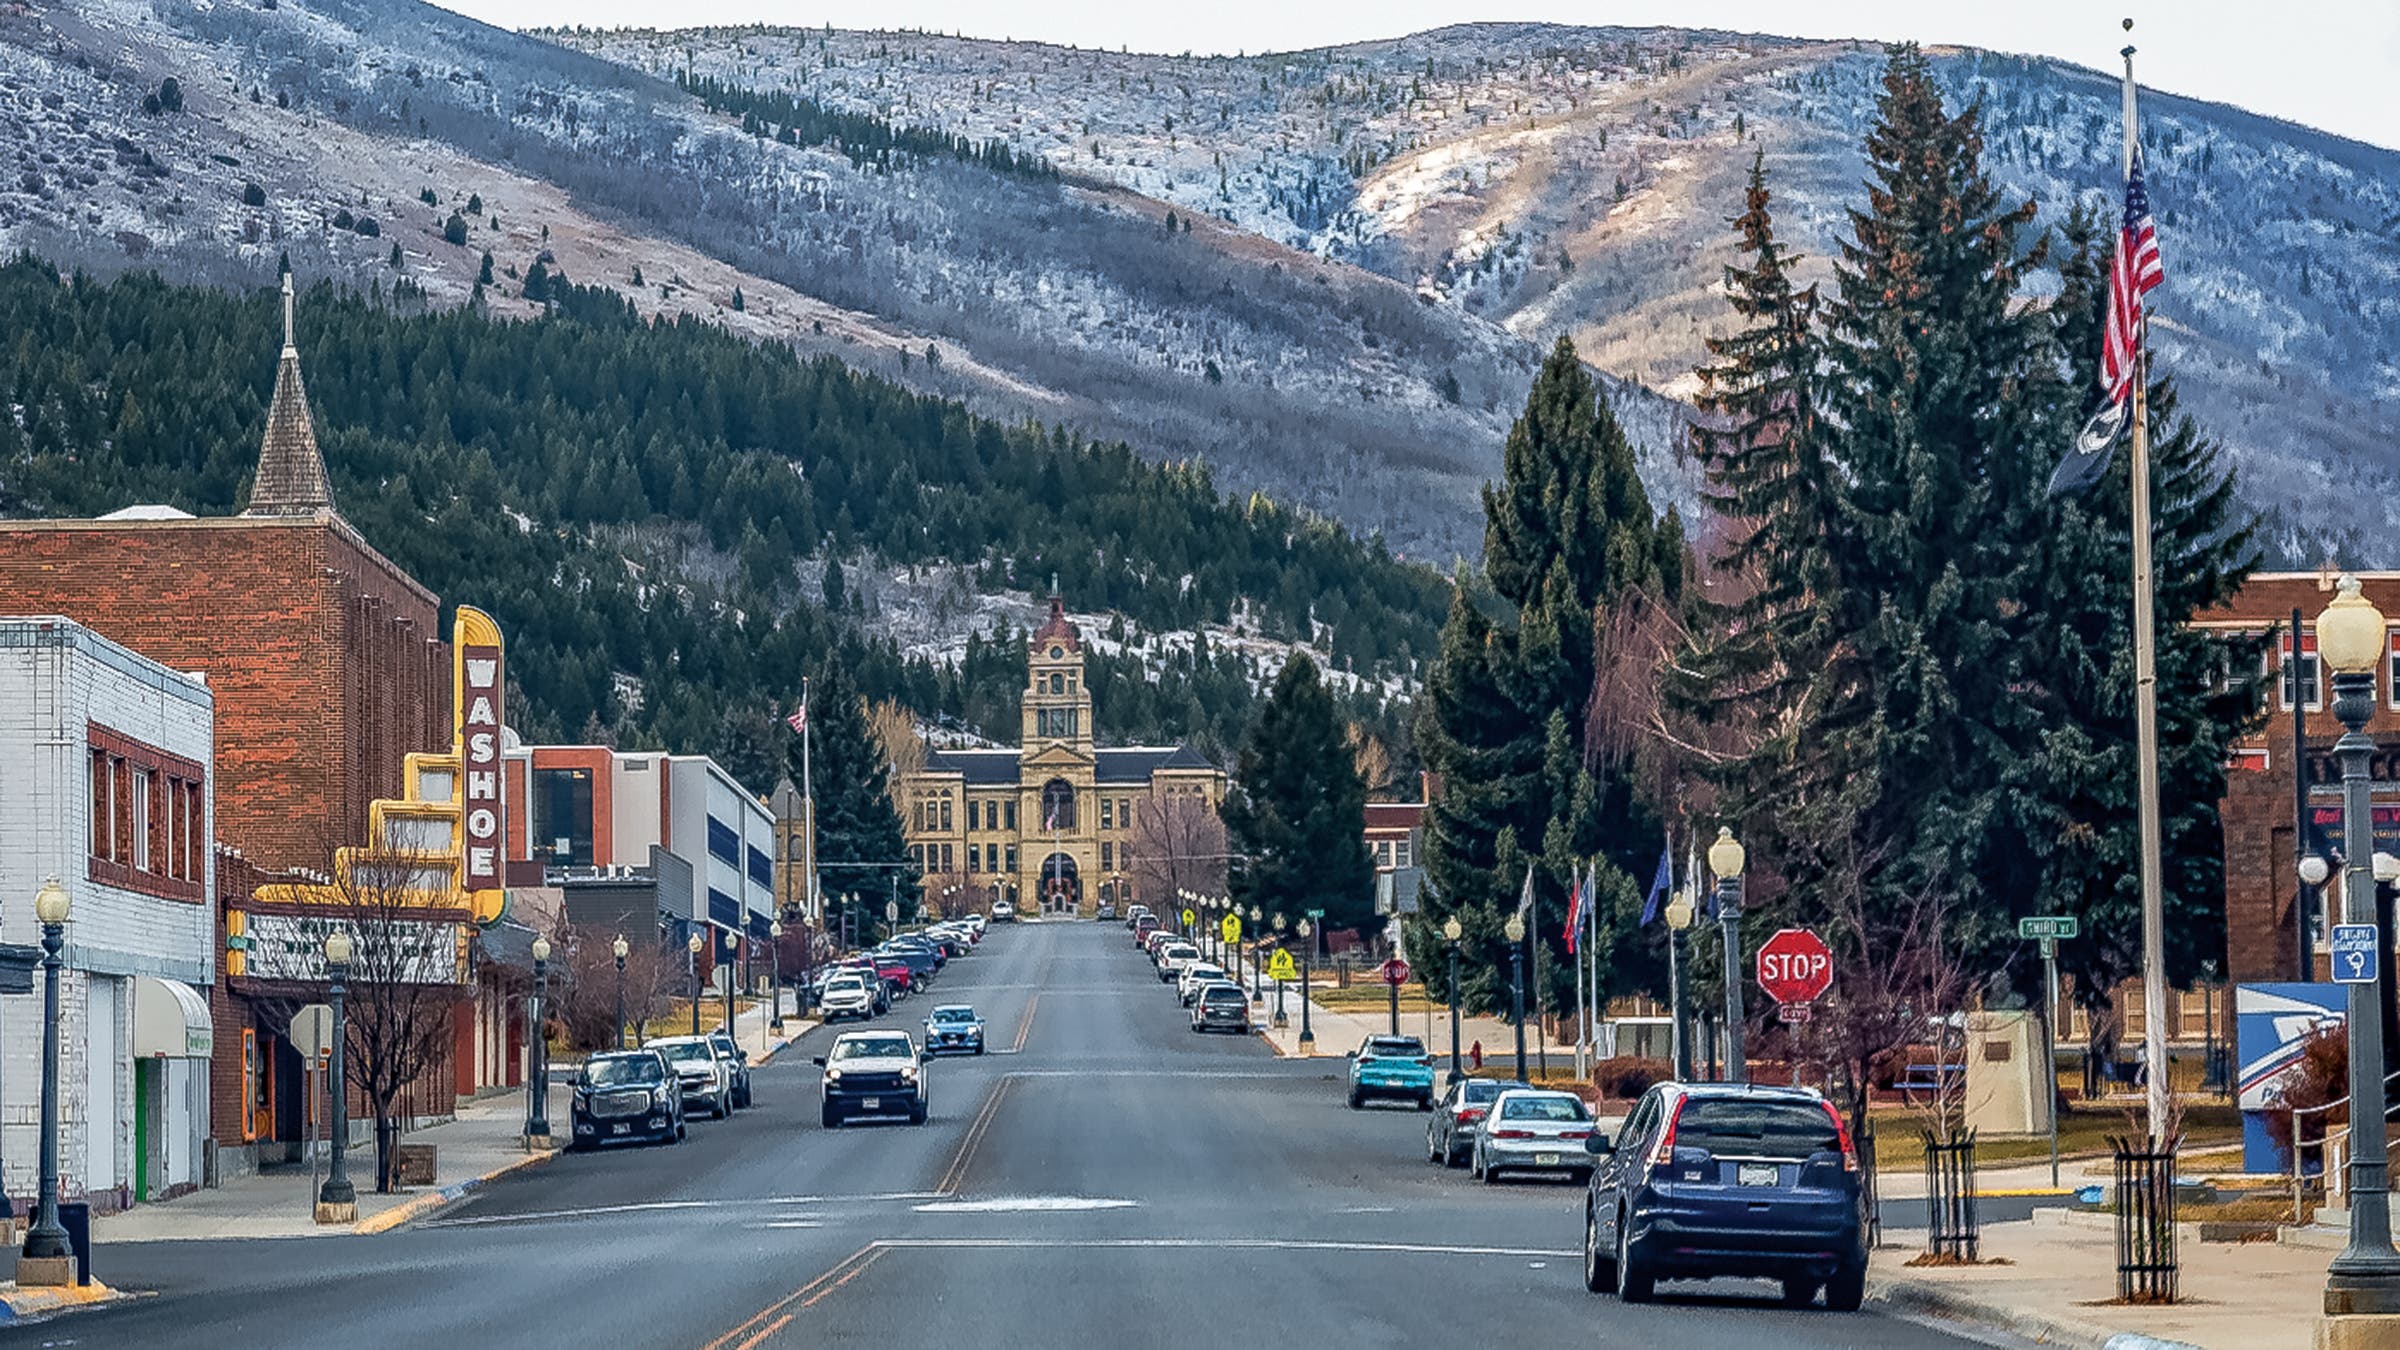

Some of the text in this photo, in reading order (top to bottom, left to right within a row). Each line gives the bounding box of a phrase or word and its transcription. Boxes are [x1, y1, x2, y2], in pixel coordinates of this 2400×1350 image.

[465, 659, 498, 877] WASHOE
[1386, 966, 1409, 978] SOP
[1764, 953, 1826, 981] STOP
